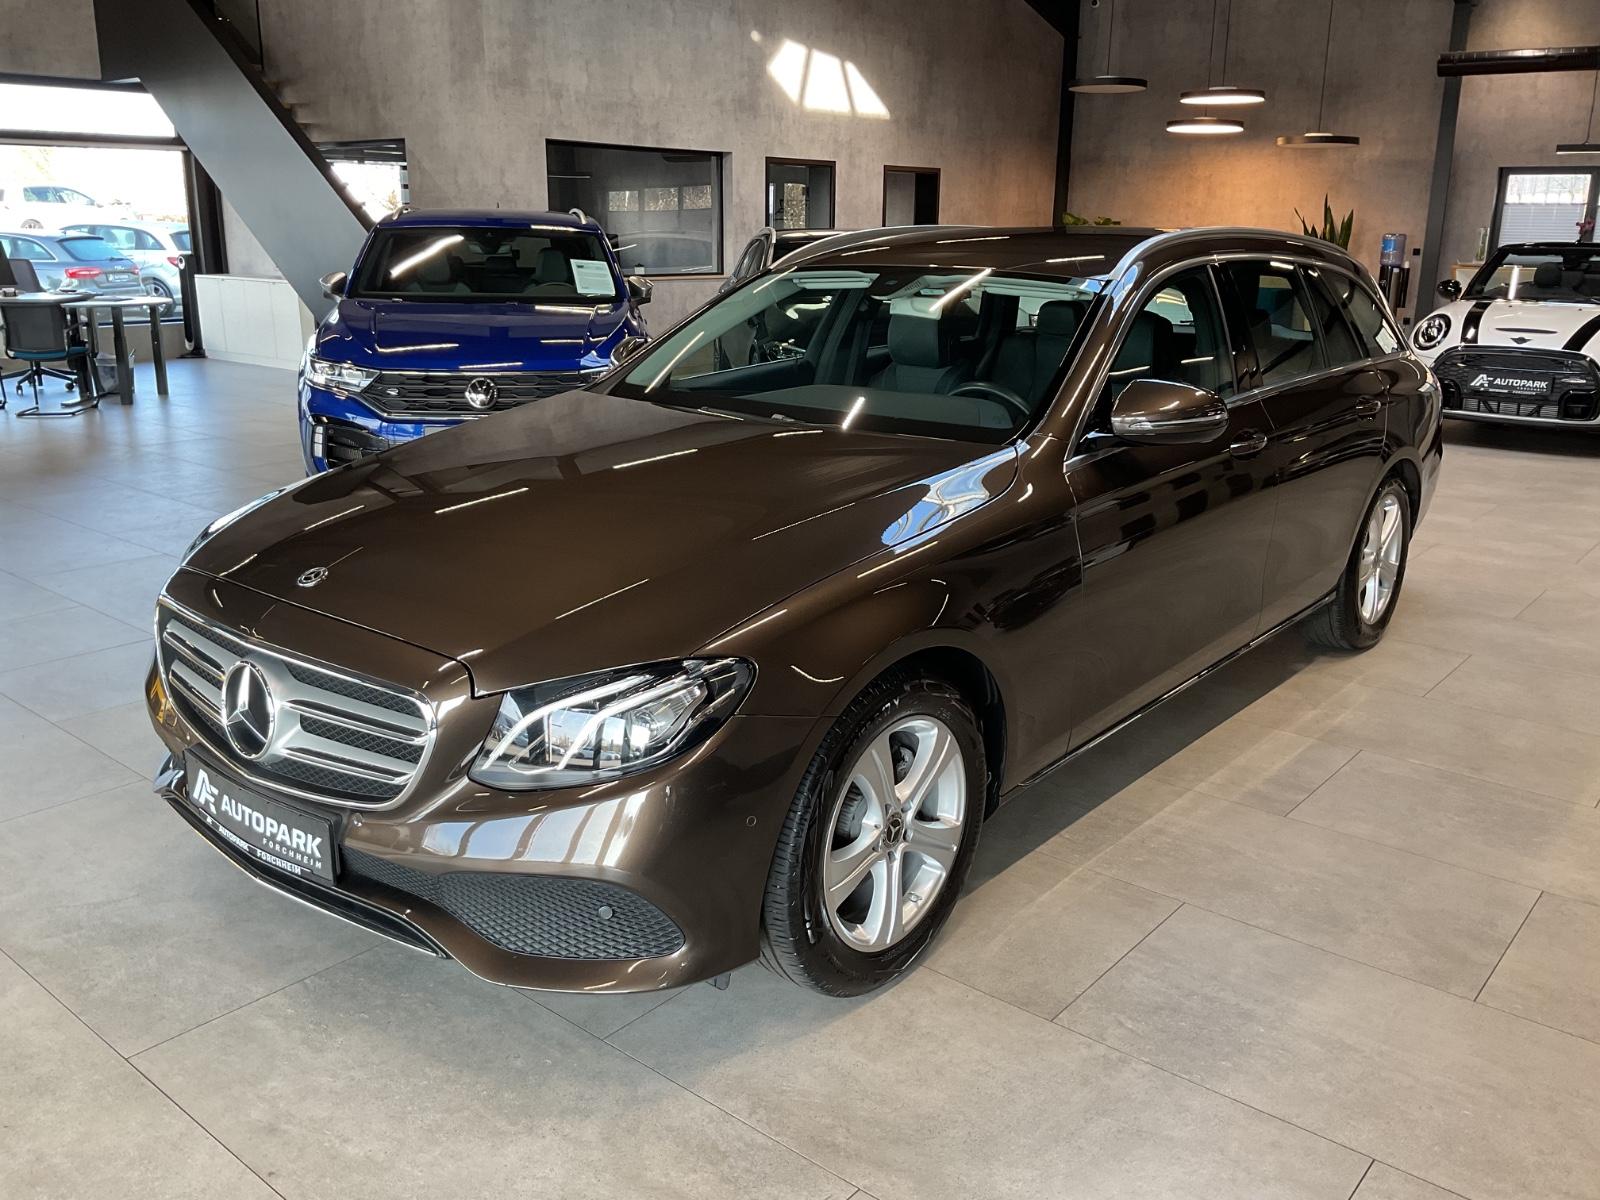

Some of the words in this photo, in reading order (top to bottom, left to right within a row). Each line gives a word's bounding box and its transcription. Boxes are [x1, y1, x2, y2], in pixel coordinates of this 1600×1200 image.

[1493, 378, 1549, 389] AUTOPARK
[221, 794, 322, 858] AUTOPARK
[256, 849, 302, 875] FORCHHEIM
[262, 838, 322, 869] FORCHHEIM
